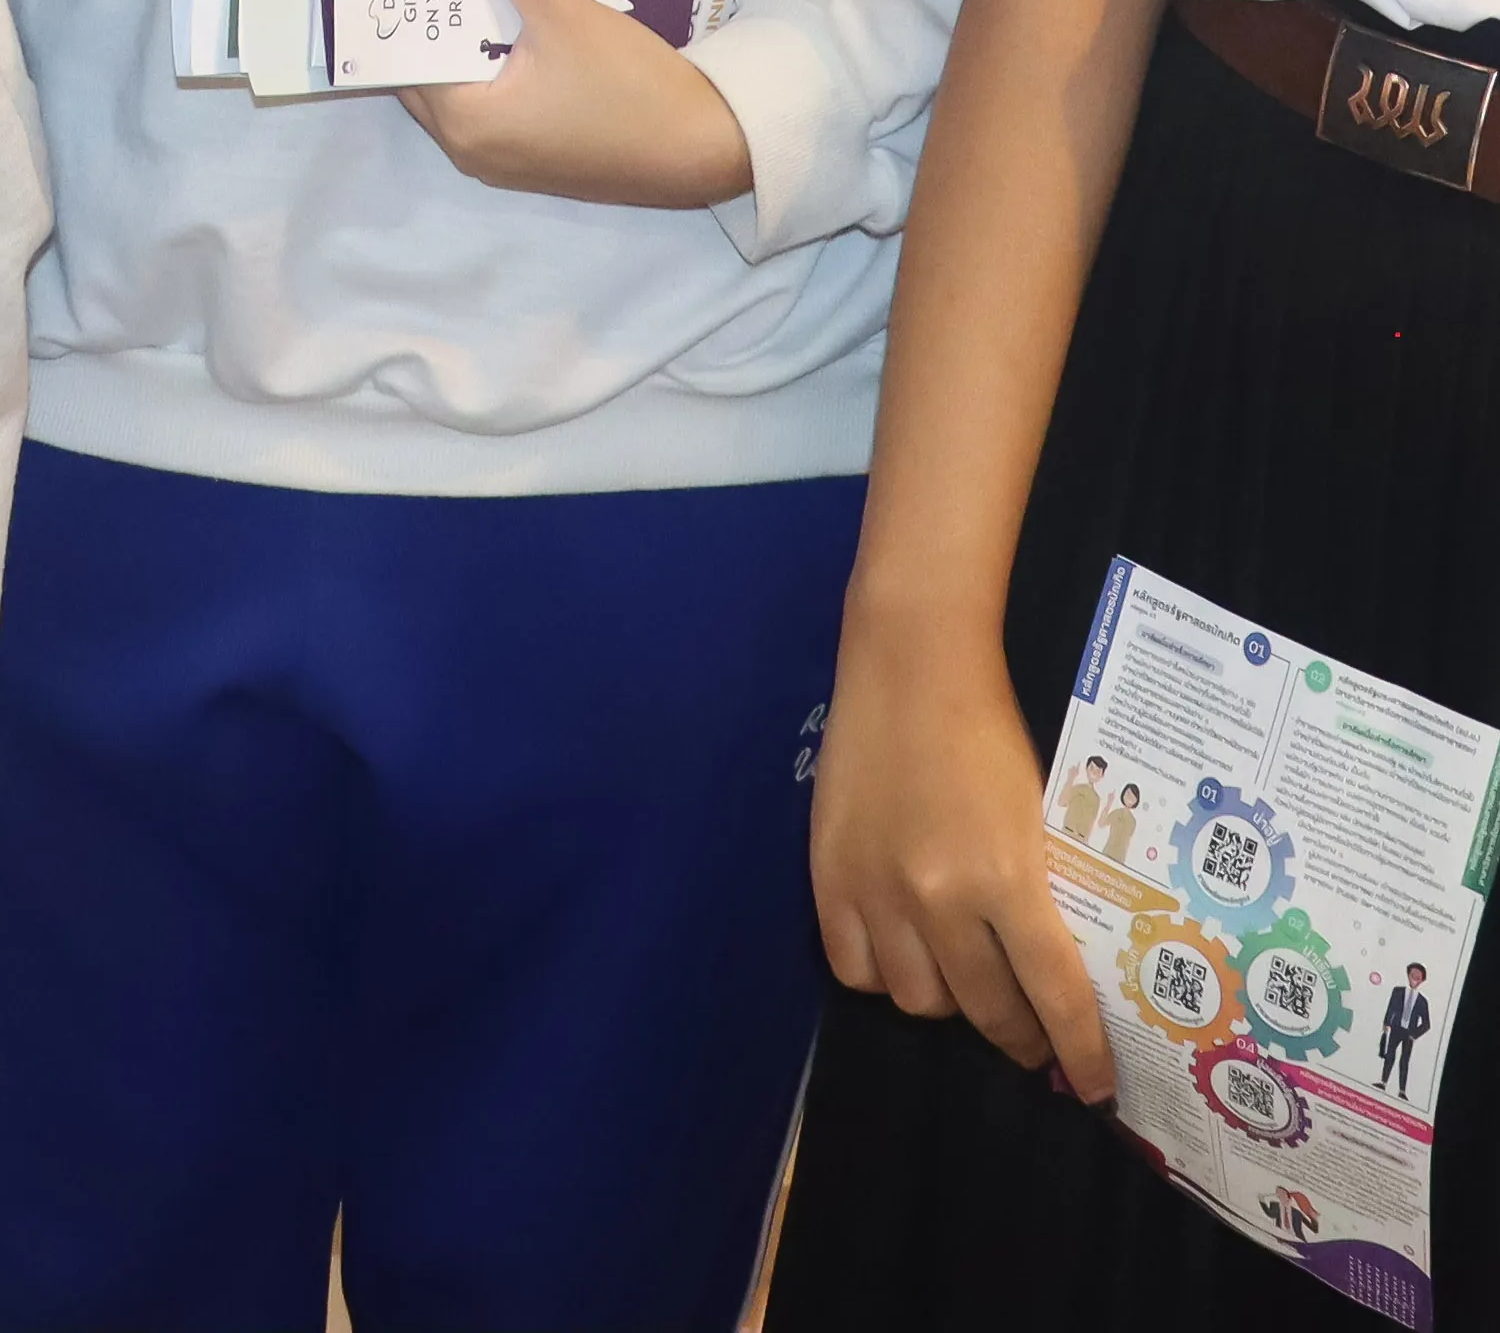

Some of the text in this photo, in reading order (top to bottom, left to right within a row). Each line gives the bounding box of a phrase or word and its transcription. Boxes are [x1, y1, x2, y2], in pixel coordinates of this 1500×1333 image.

[426, 12, 441, 41] ON
[1246, 638, 1267, 658] 01
[1199, 783, 1219, 803] 01
[1236, 1037, 1256, 1055] 04
